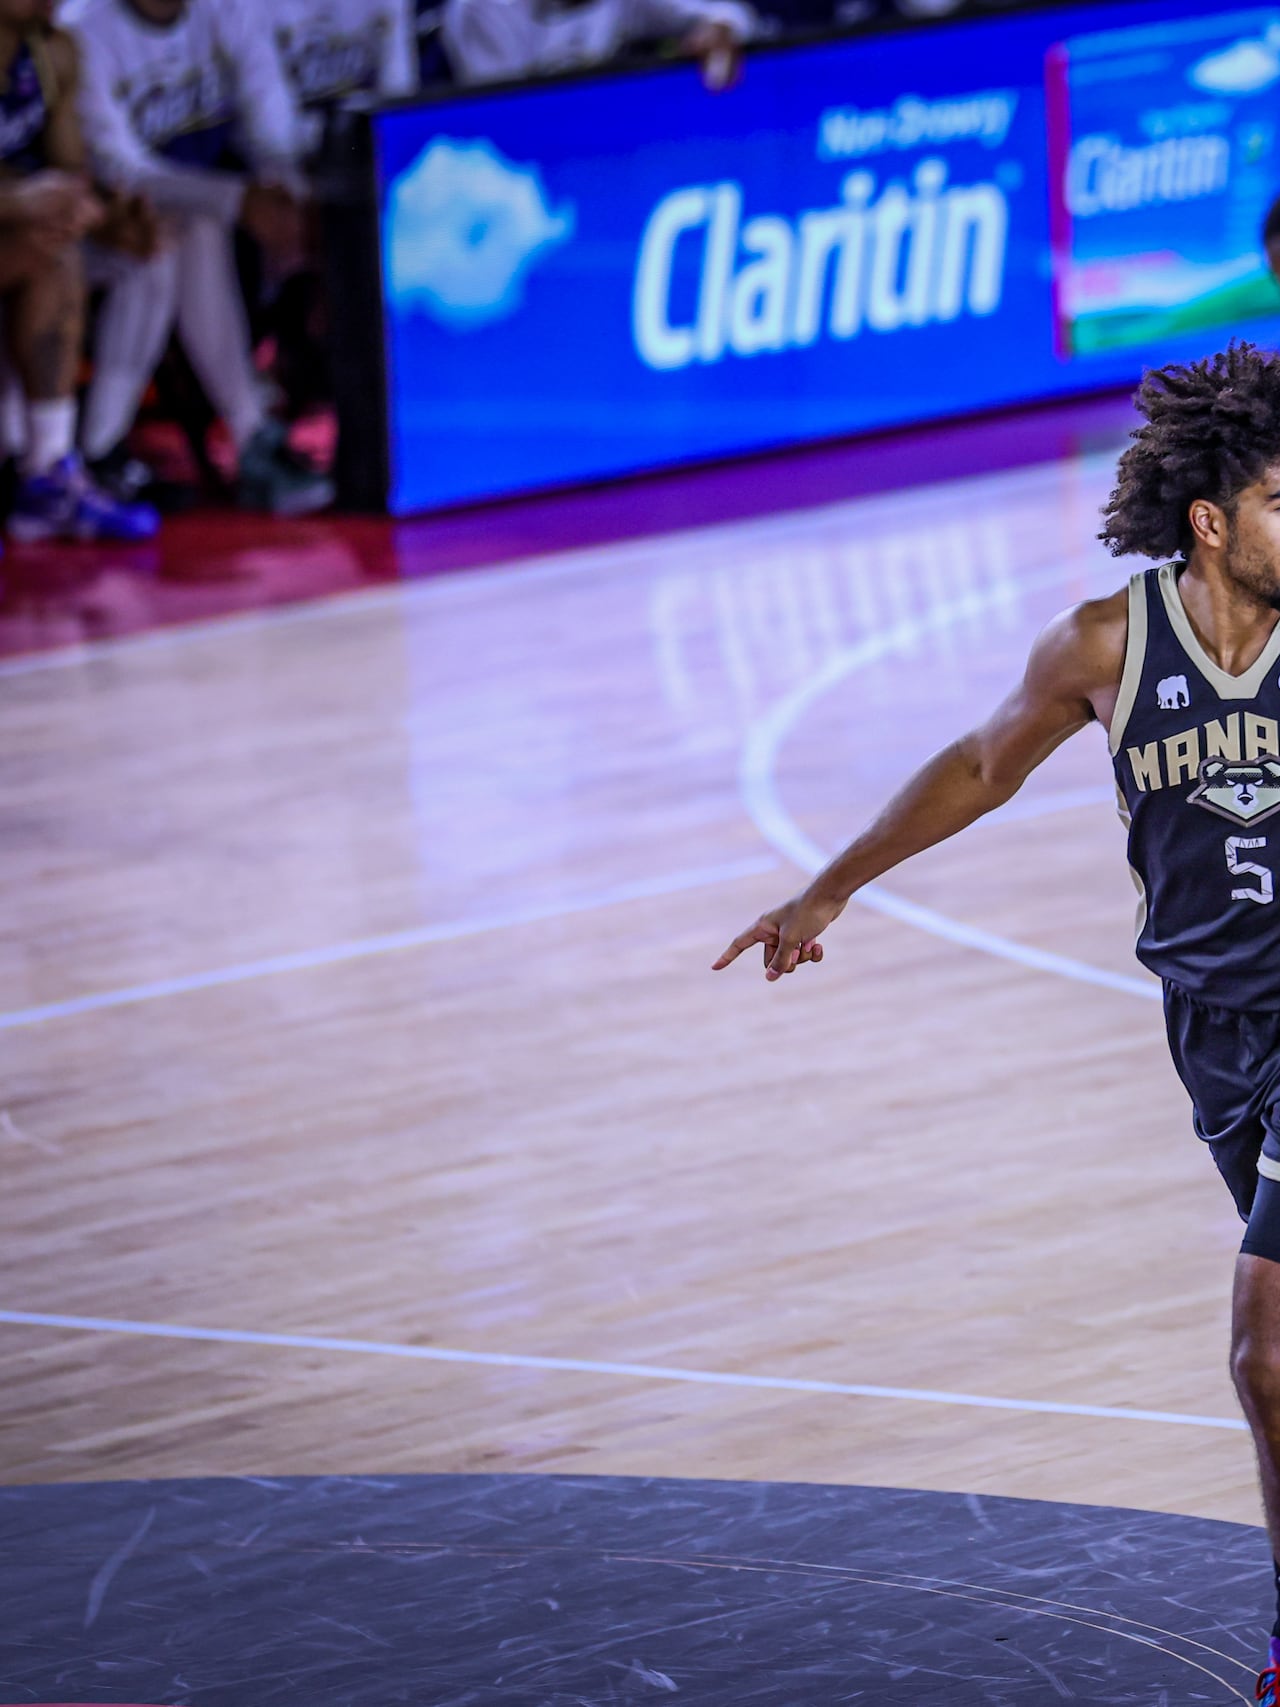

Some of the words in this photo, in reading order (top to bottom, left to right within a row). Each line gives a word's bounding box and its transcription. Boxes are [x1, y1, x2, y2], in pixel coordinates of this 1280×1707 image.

[1066, 134, 1230, 218] Claritin
[632, 156, 1009, 371] Claritin
[1224, 836, 1274, 905] 5
